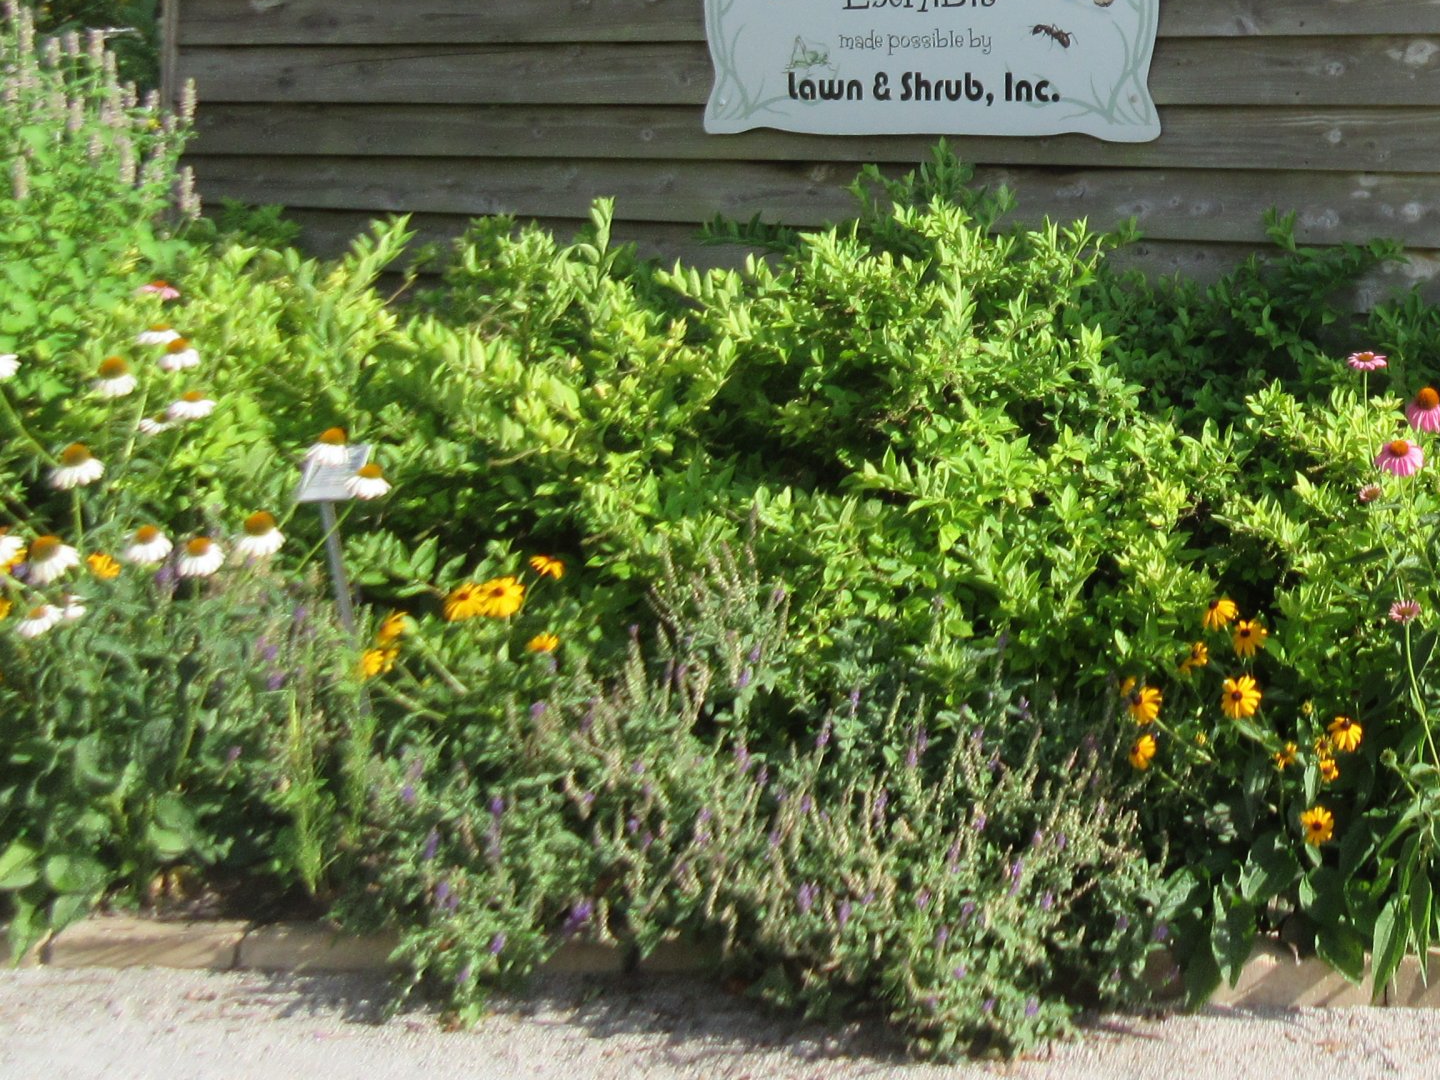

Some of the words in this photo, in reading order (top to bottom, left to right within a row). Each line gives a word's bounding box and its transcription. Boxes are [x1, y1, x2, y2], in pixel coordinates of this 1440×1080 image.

[838, 29, 883, 50] made
[888, 29, 964, 55] possible
[968, 28, 993, 55] by
[873, 72, 892, 102] &
[900, 72, 995, 107] Shrub,
[1004, 72, 1061, 102] Inc.
